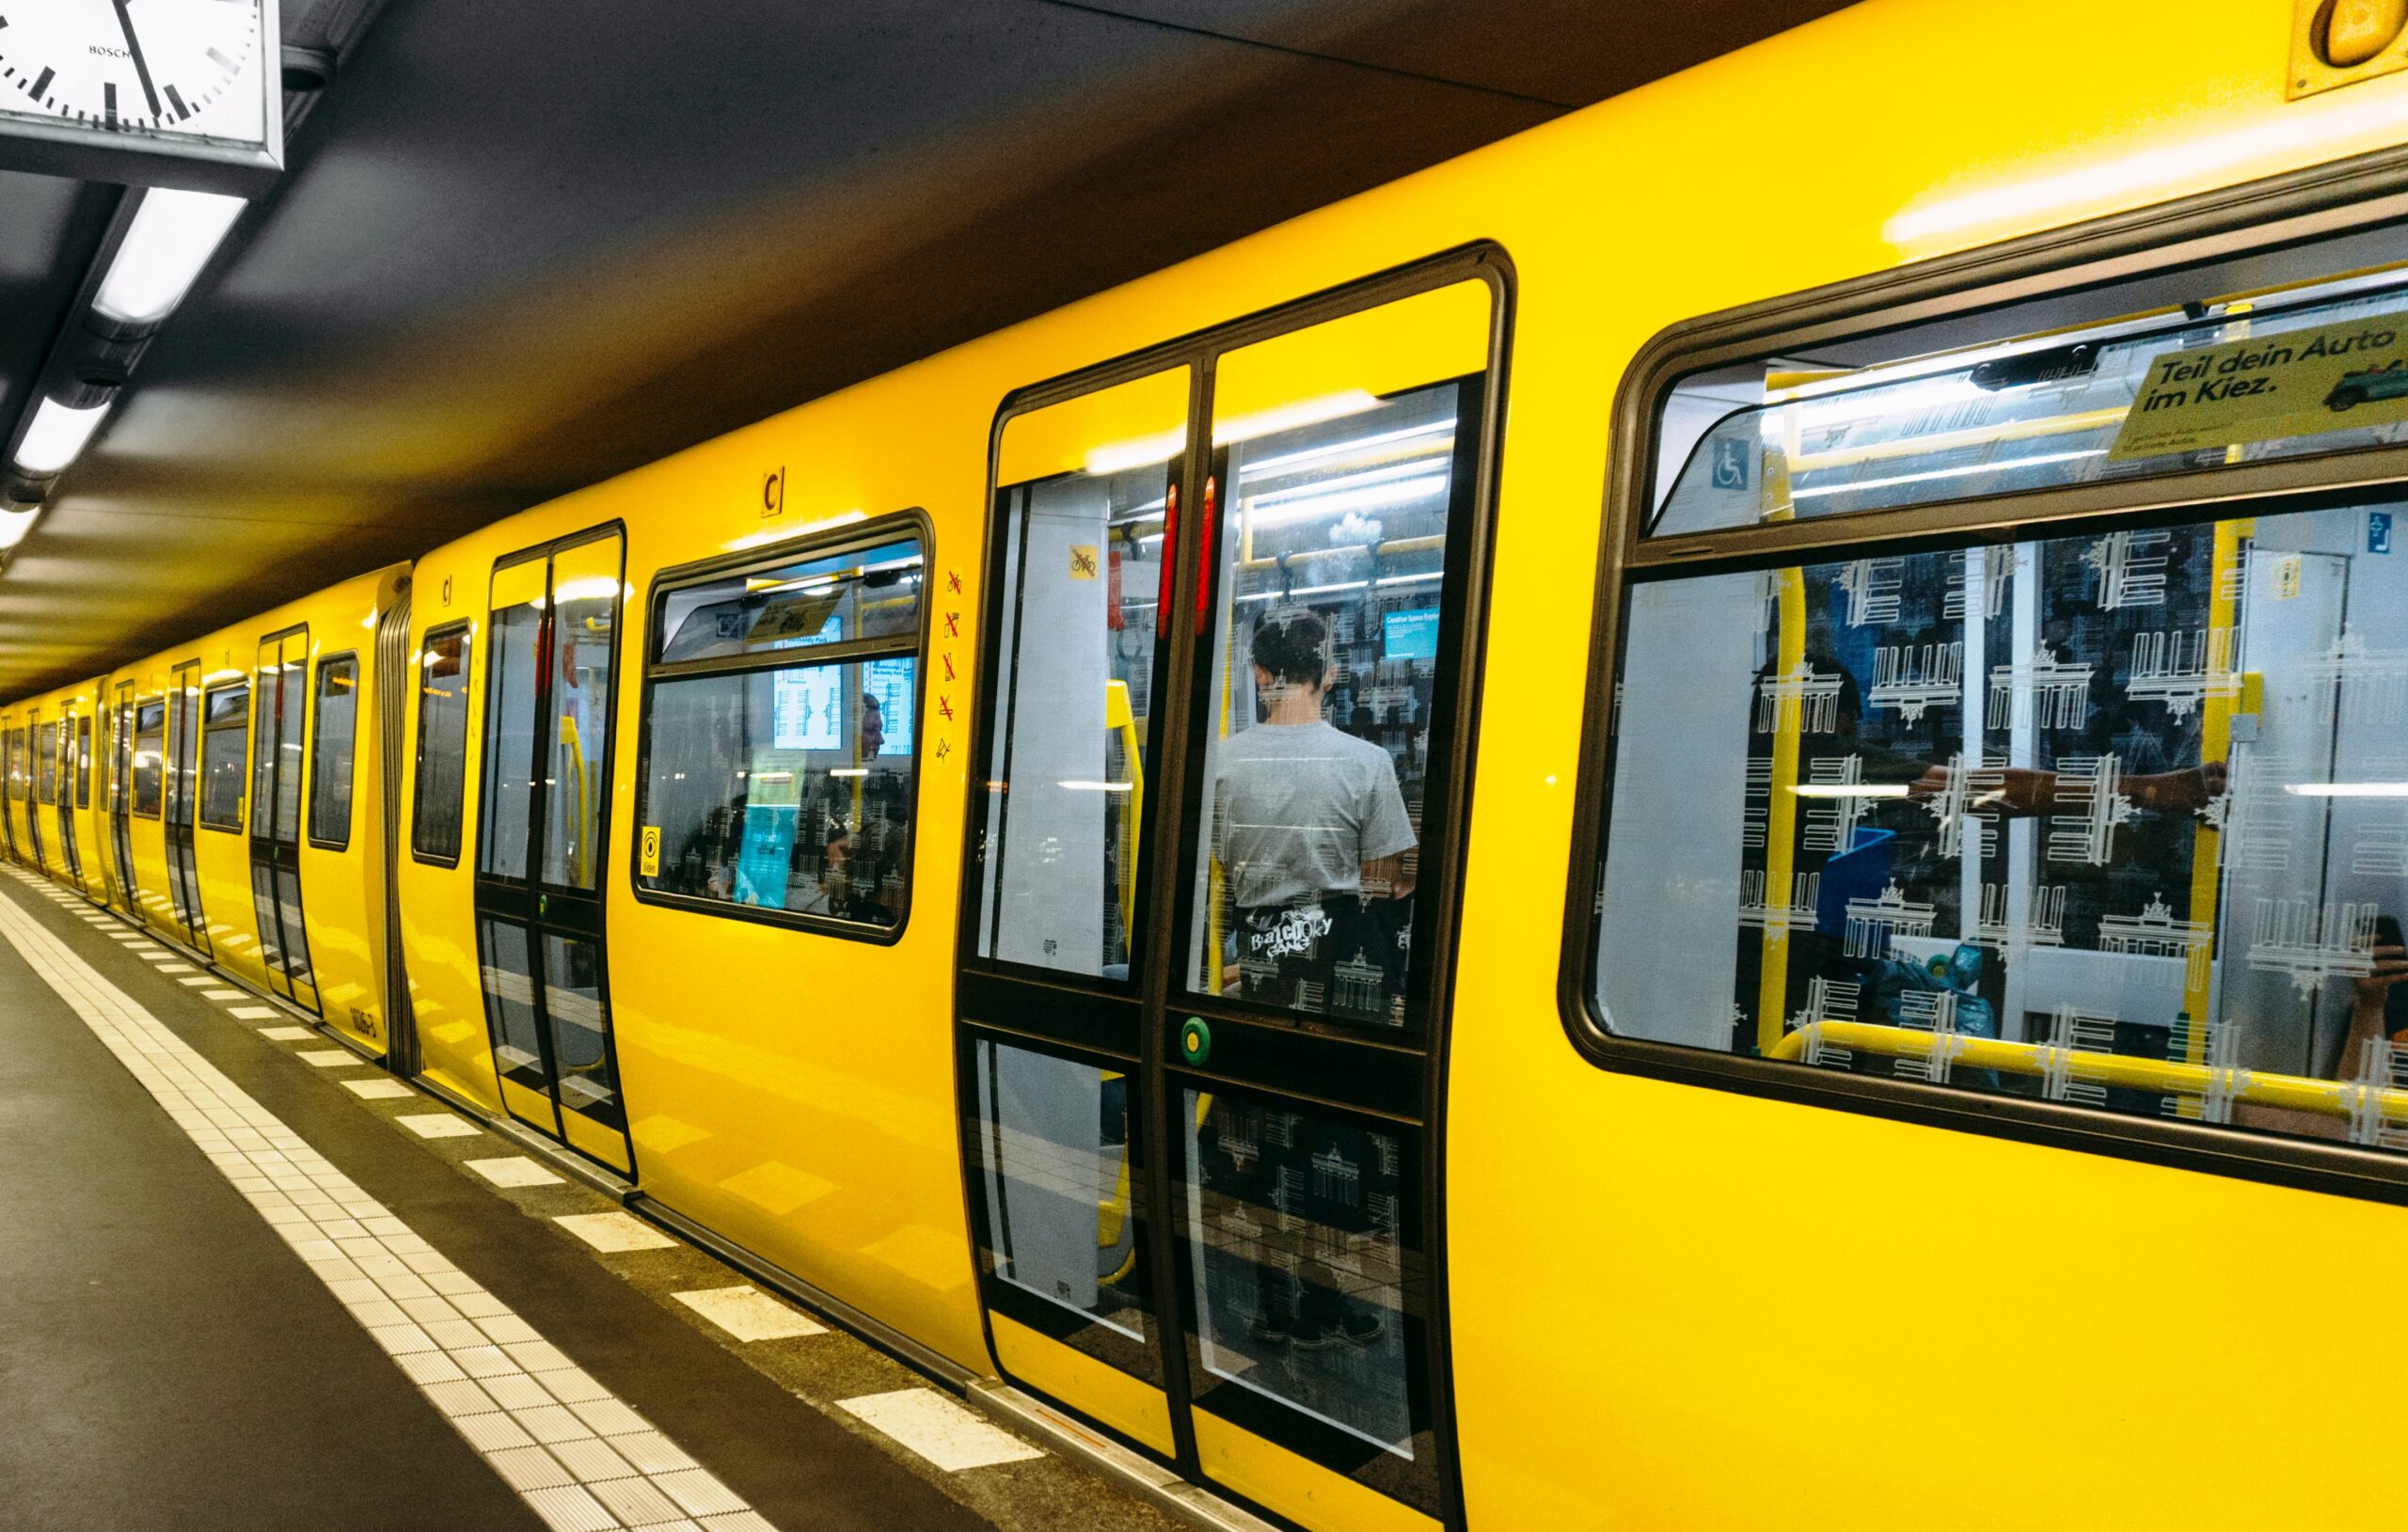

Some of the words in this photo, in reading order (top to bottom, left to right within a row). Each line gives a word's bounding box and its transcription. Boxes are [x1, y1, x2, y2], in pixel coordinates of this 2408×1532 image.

[88, 44, 131, 58] BOSCH
[2160, 355, 2214, 385] Teil
[2217, 344, 2293, 374] dein
[2297, 330, 2396, 361] Auto
[2143, 388, 2187, 412] im
[2194, 376, 2277, 403] Kiez.
[643, 861, 656, 873] Video
